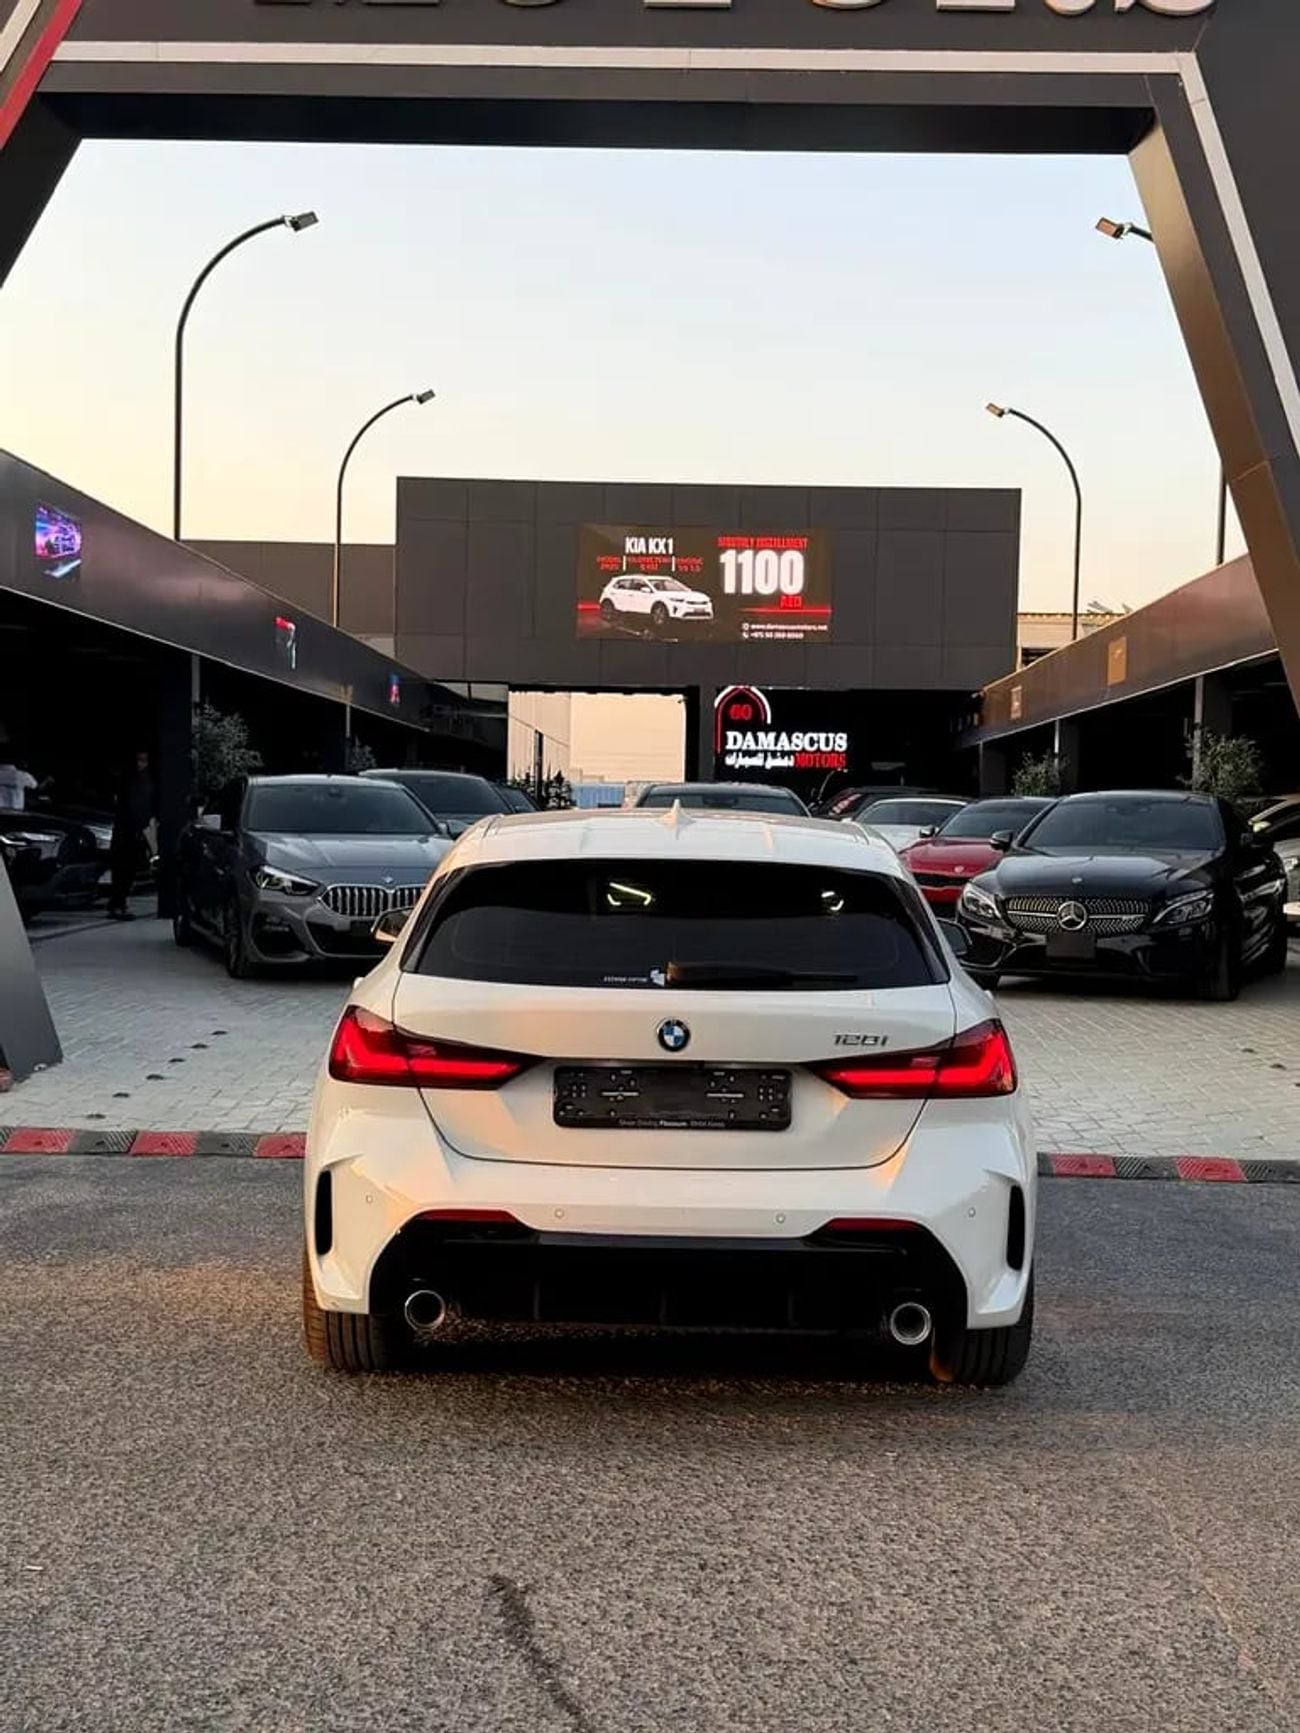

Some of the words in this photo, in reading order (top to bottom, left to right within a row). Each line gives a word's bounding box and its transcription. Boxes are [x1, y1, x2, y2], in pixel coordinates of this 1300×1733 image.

[624, 536, 646, 554] KIA
[720, 549, 804, 595] 1100
[725, 731, 847, 752] DAMASCUS
[795, 753, 846, 768] MOTORS
